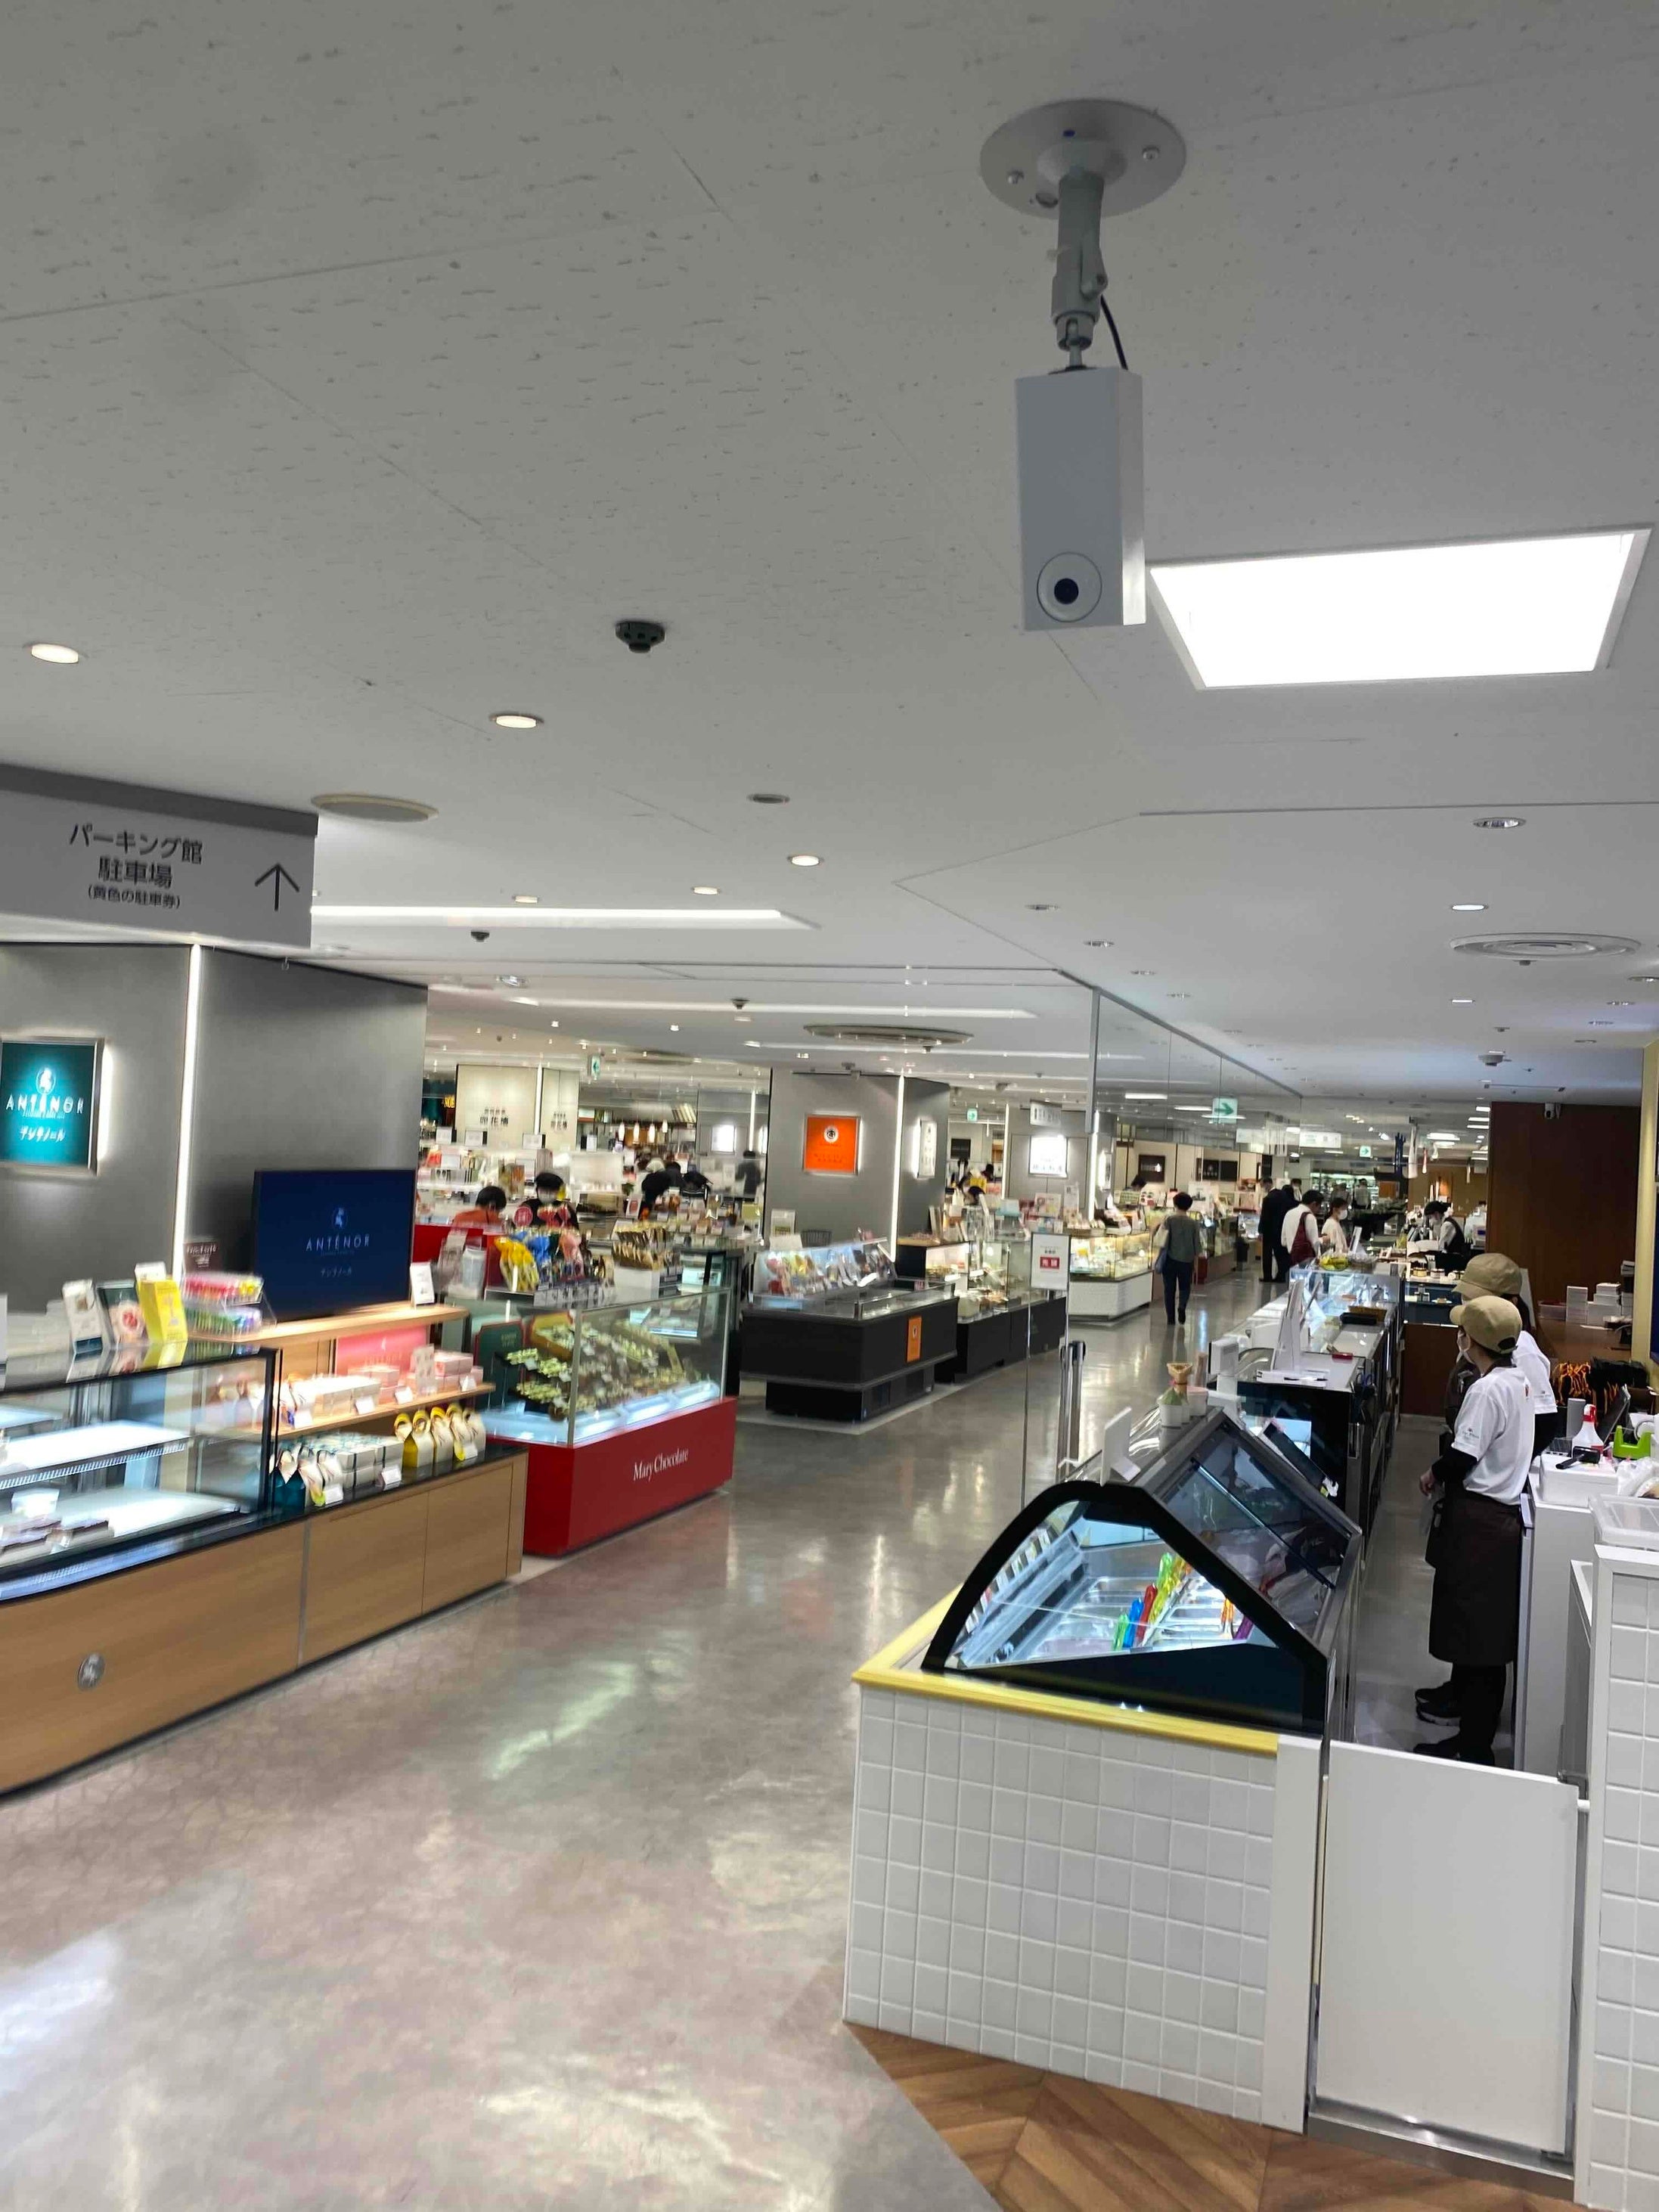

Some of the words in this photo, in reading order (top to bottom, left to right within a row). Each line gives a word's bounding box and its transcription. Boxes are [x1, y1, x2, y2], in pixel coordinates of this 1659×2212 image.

[70, 823, 203, 864] パーキング館
[98, 855, 172, 889] 駐車場
[633, 1460, 654, 1482] Mary
[654, 1447, 689, 1473] Chocolate
